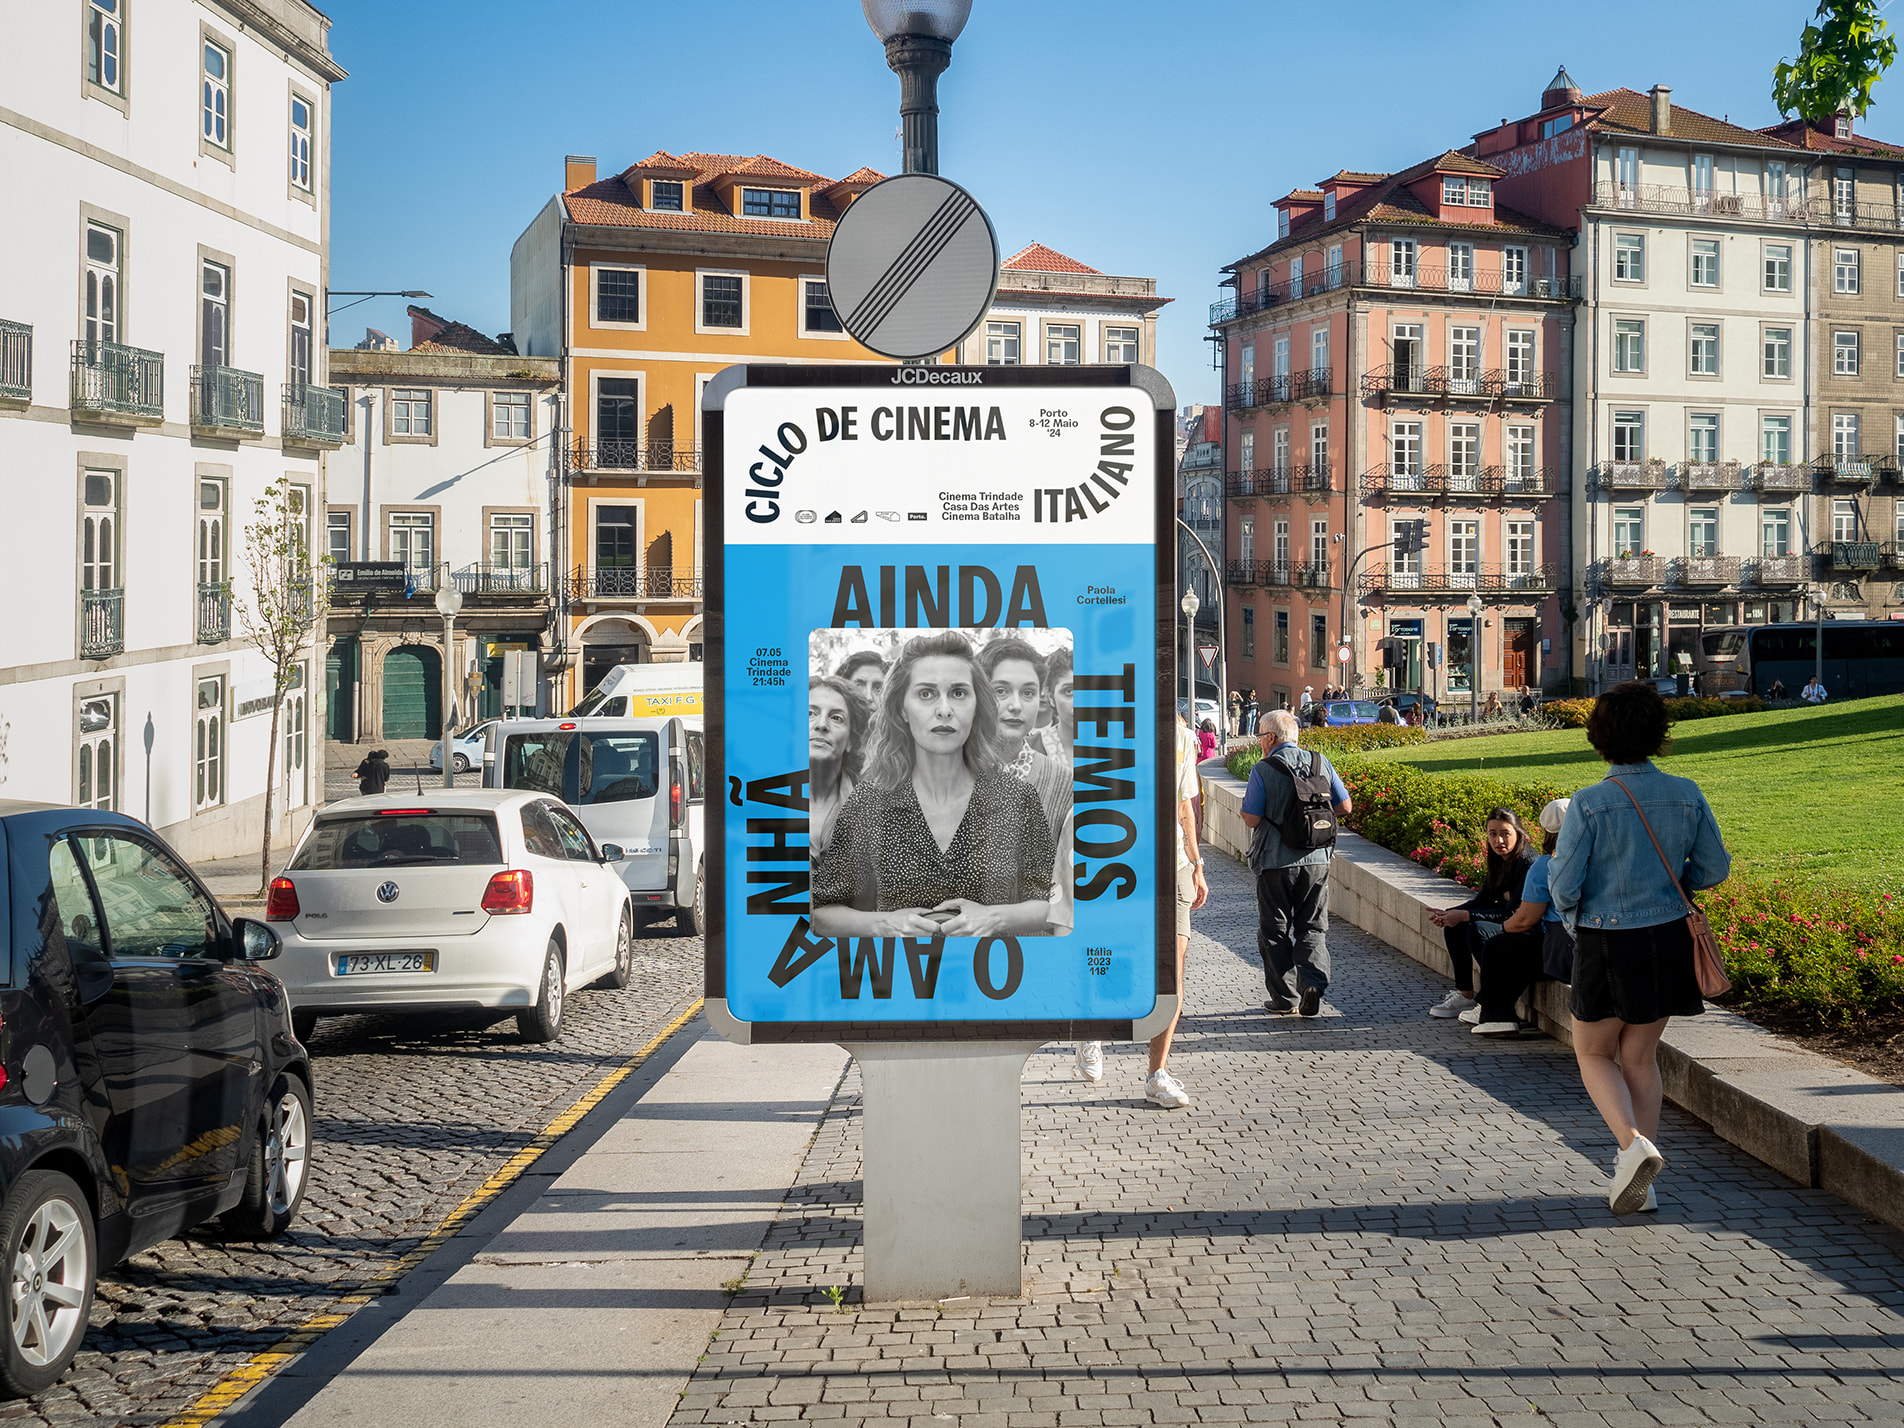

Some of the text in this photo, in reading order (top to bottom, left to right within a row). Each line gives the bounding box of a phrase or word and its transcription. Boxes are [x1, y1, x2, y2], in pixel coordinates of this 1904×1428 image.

[891, 369, 983, 384] JCDecaux
[1040, 409, 1068, 418] Porto
[1029, 419, 1079, 428] 8-12 Maio
[745, 405, 1136, 523] CICLO DE CINEMA ITALIANO
[939, 492, 1024, 502] Cinema Trindade
[943, 502, 1020, 511] Casa Das Artes
[942, 512, 1021, 521] Cinema Batalha
[1087, 586, 1116, 595] Paola
[831, 565, 1049, 628] AINDA
[1077, 595, 1127, 605] Cortellesi
[756, 648, 782, 657] 07.05
[749, 657, 789, 667] Cinema
[746, 667, 791, 677] Trindade
[753, 677, 785, 686] 21:45h
[645, 697, 672, 706] TAXI
[1073, 663, 1138, 902] TEMOS
[1086, 947, 1112, 957] Itália
[1087, 957, 1111, 966] 2023
